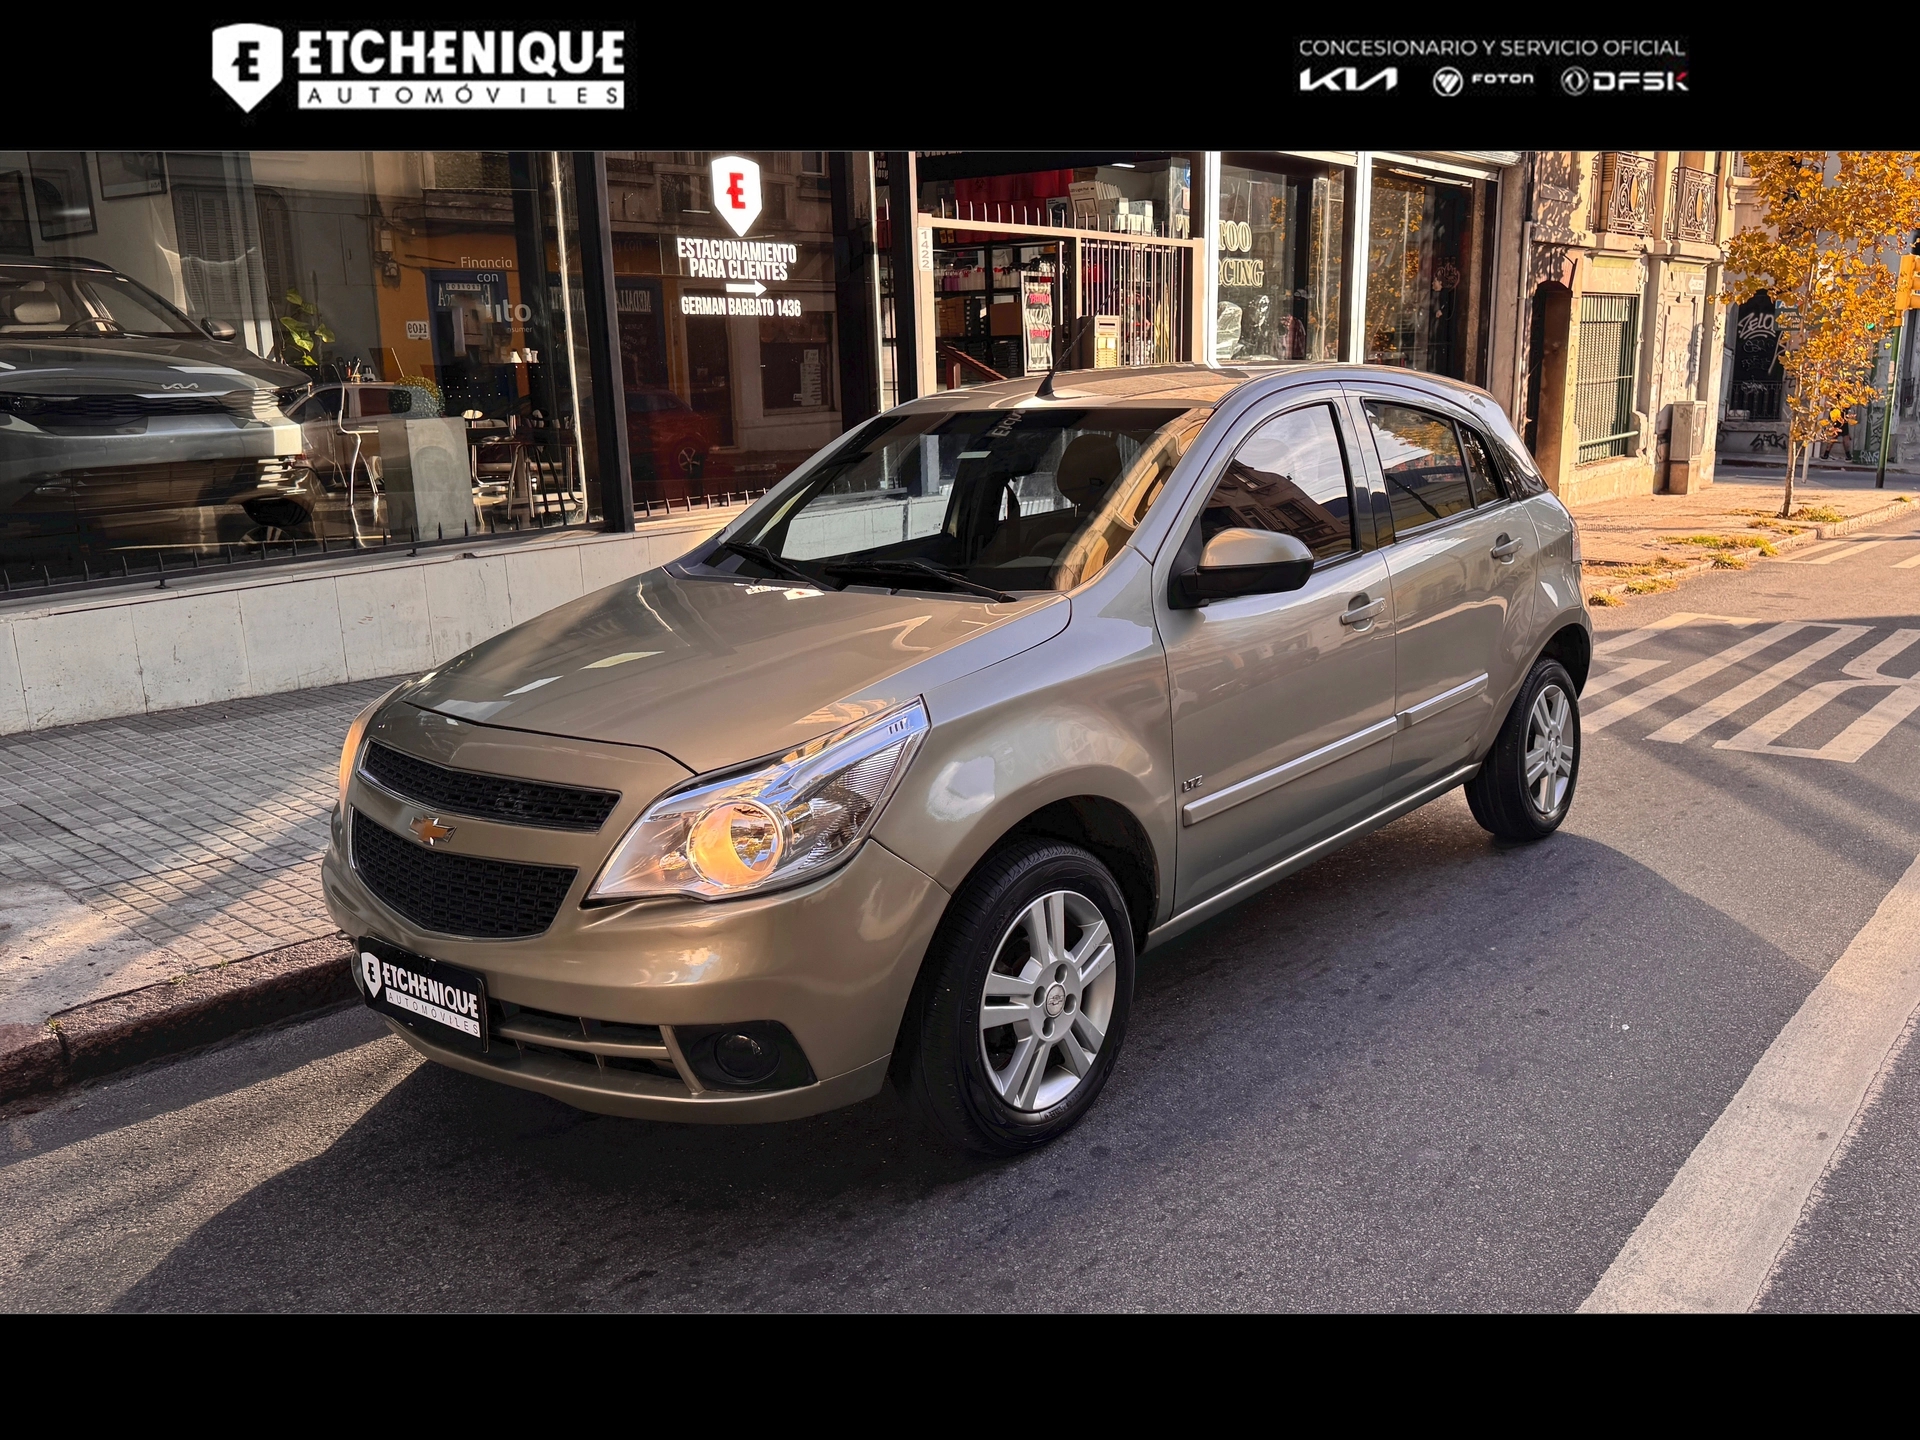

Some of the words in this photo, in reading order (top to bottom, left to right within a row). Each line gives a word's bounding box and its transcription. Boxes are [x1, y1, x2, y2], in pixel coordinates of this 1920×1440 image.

[677, 237, 797, 263] ESTACIONAMIENTO
[920, 230, 931, 269] 1422
[460, 256, 513, 269] Financia
[689, 258, 726, 278] PARA
[728, 259, 788, 281] CLIENTES
[476, 273, 499, 283] con
[681, 296, 727, 316] GERMAN
[728, 297, 774, 316] BARBATO
[776, 299, 801, 317] 1436
[382, 961, 479, 1019] ETCHENIQUE
[387, 991, 479, 1035] AUTOMÓVILES
